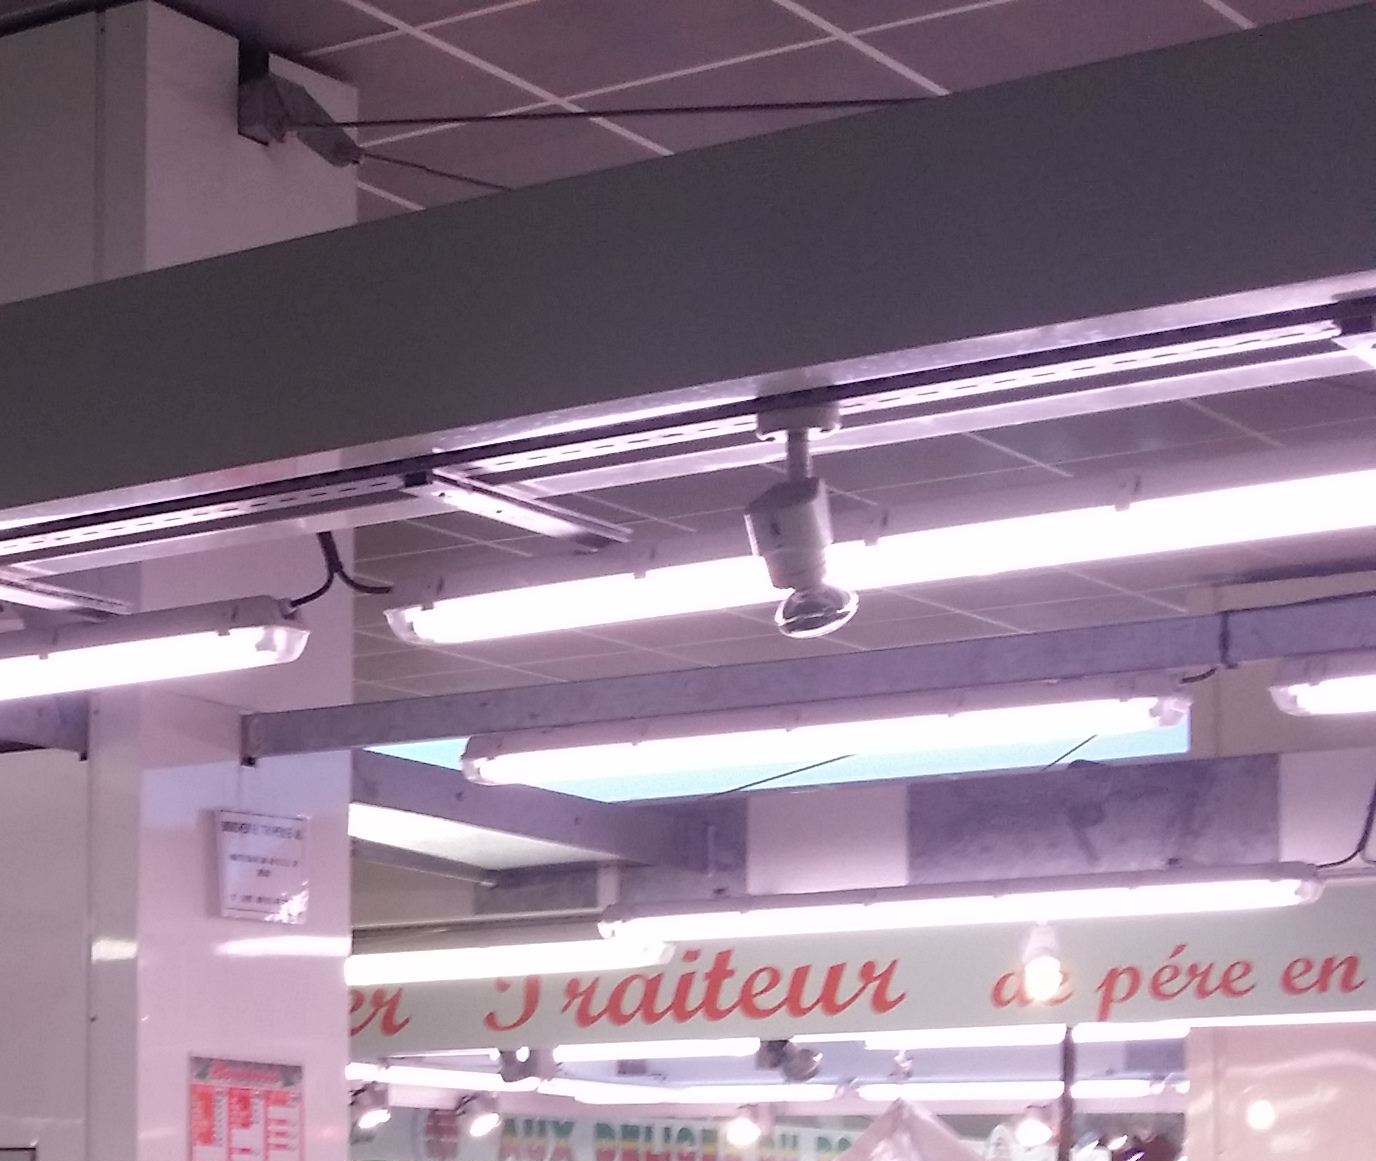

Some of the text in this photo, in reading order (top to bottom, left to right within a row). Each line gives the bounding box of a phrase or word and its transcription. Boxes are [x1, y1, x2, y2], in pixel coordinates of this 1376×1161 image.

[484, 949, 905, 1031] Traiteur
[1096, 943, 1258, 1023] pére
[1281, 953, 1368, 996] en
